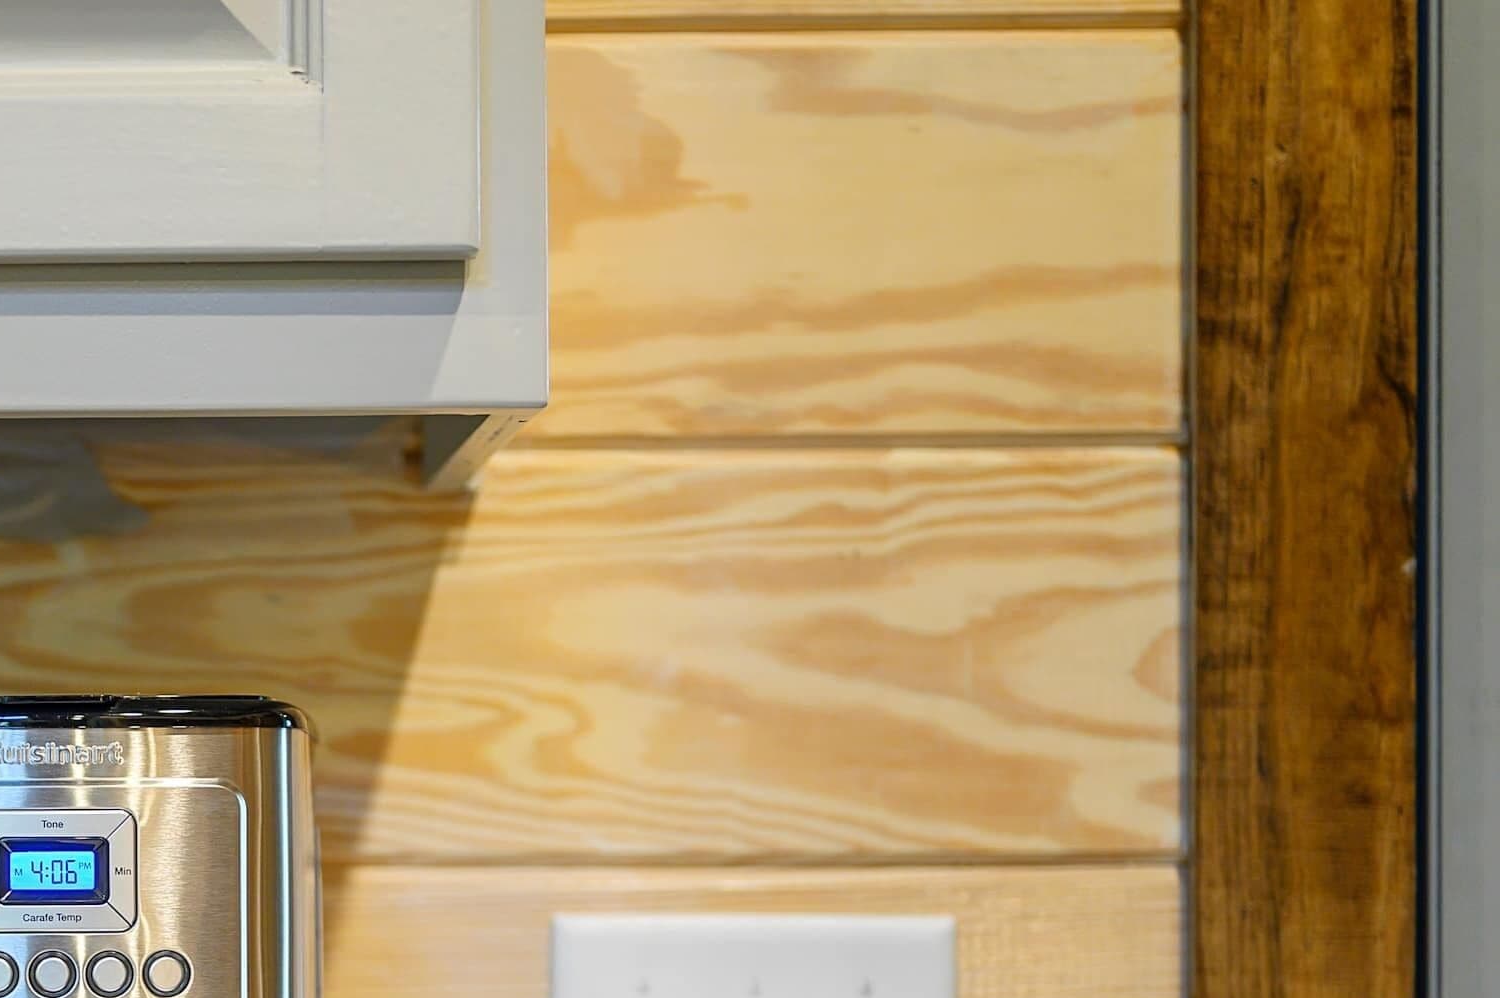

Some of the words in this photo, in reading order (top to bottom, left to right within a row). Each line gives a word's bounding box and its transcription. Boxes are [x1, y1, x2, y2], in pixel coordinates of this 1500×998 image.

[41, 819, 64, 829] Tone
[31, 859, 78, 885] 4:06
[78, 862, 92, 870] PM
[114, 866, 132, 876] Min
[22, 912, 54, 923] Carafe
[57, 912, 82, 925] Temp
